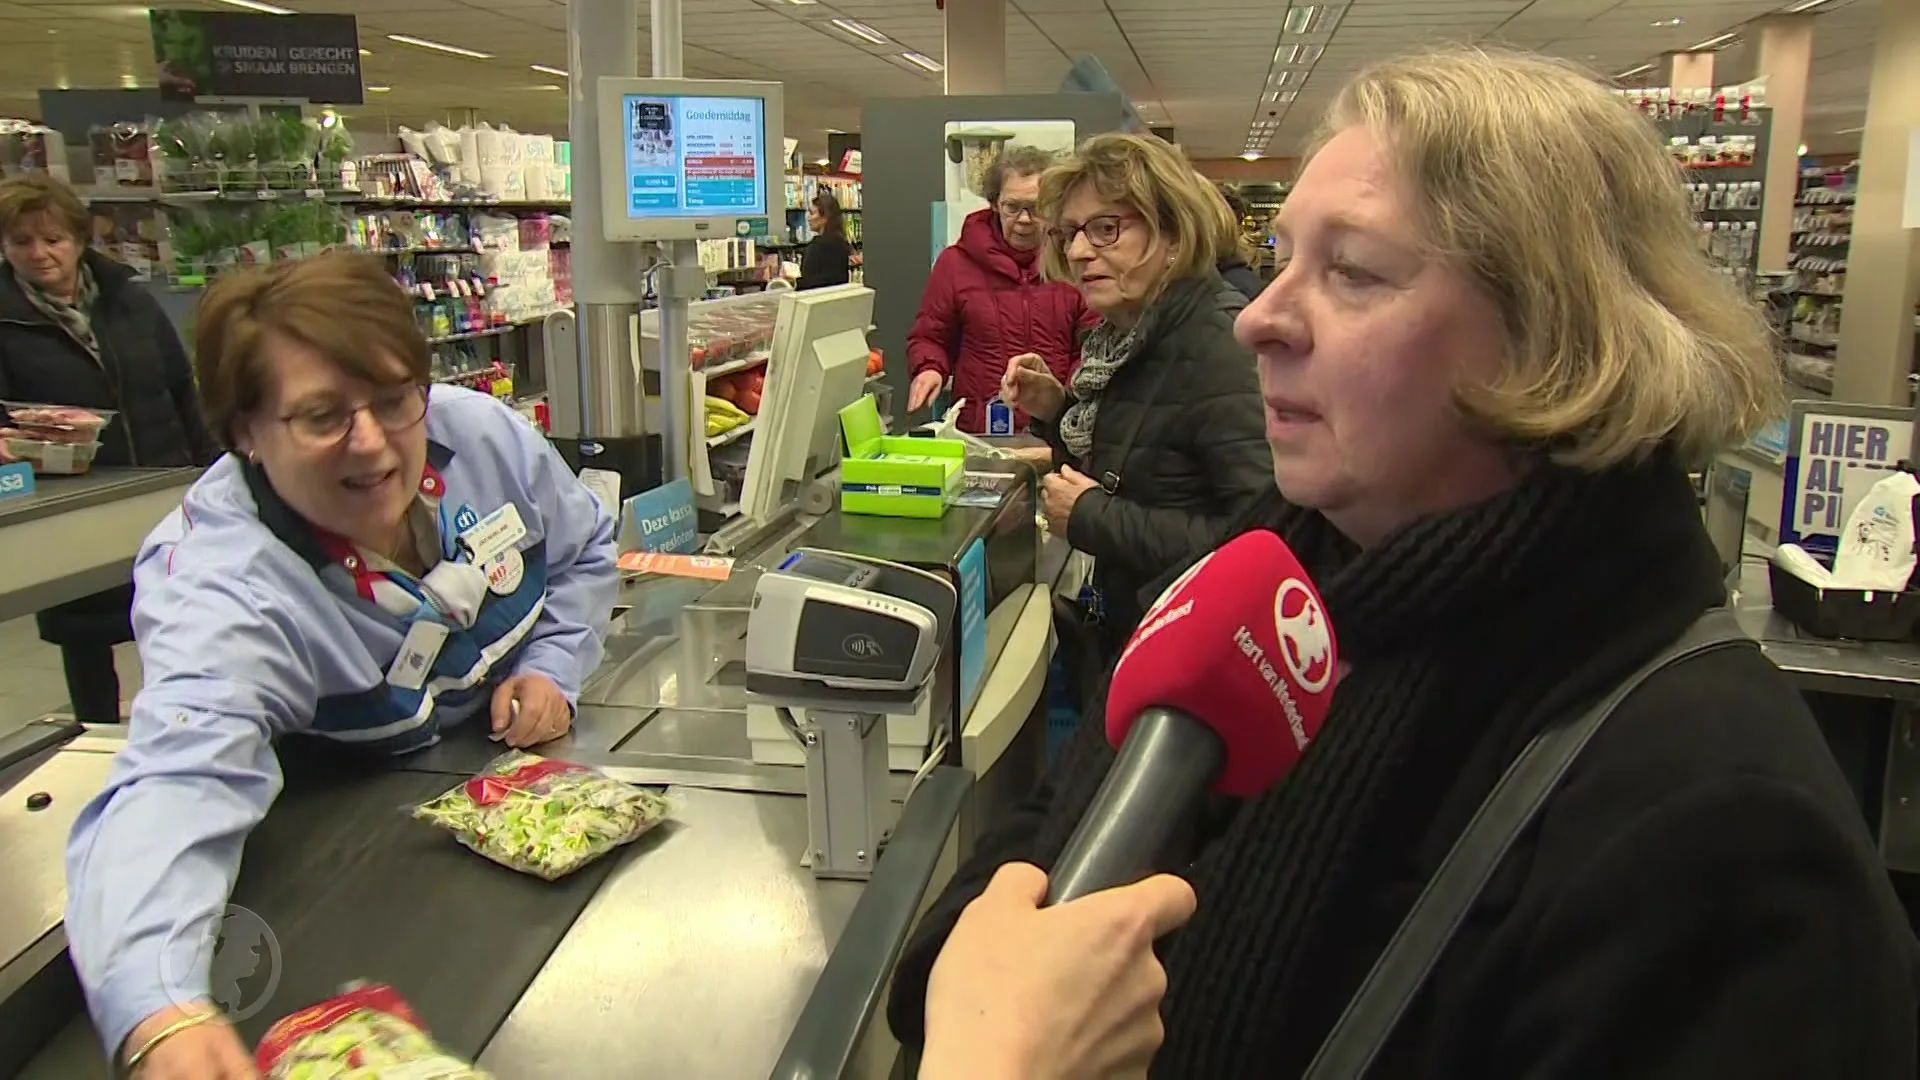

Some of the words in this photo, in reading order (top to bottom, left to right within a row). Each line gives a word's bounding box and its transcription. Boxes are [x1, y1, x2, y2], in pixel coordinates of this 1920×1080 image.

[212, 45, 277, 59] KRUIDEN
[235, 62, 286, 74] SMAAK
[288, 63, 356, 75] BRENGEN
[686, 108, 751, 122] Goedemiddag
[1809, 421, 1889, 461] HIER
[1803, 493, 1843, 529] PI
[641, 514, 670, 536] Deze
[1233, 625, 1264, 664] Hart
[1259, 657, 1279, 689] van
